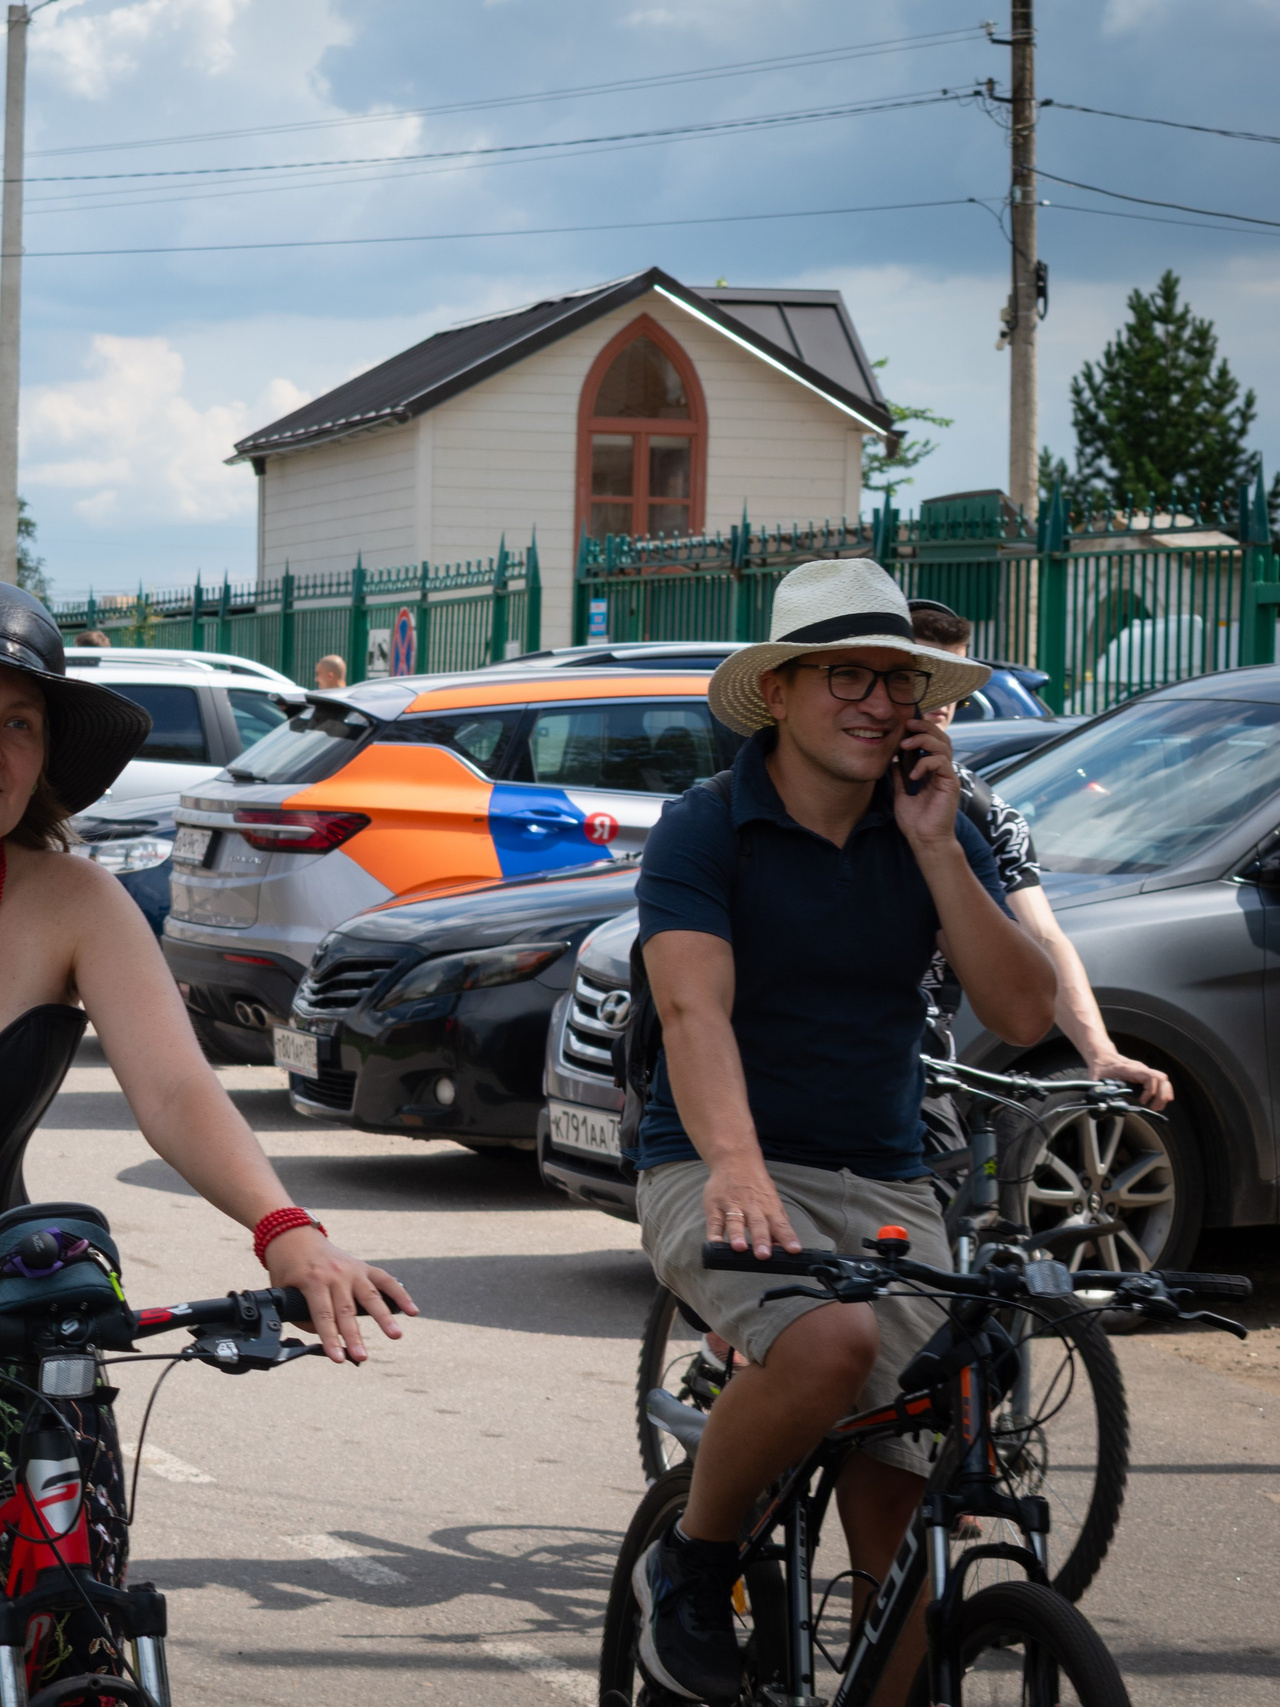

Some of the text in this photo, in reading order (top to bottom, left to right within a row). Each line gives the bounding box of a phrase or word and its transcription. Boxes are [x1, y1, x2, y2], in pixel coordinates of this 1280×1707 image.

[592, 816, 611, 839] Я
[554, 1110, 621, 1150] К791АА 7
